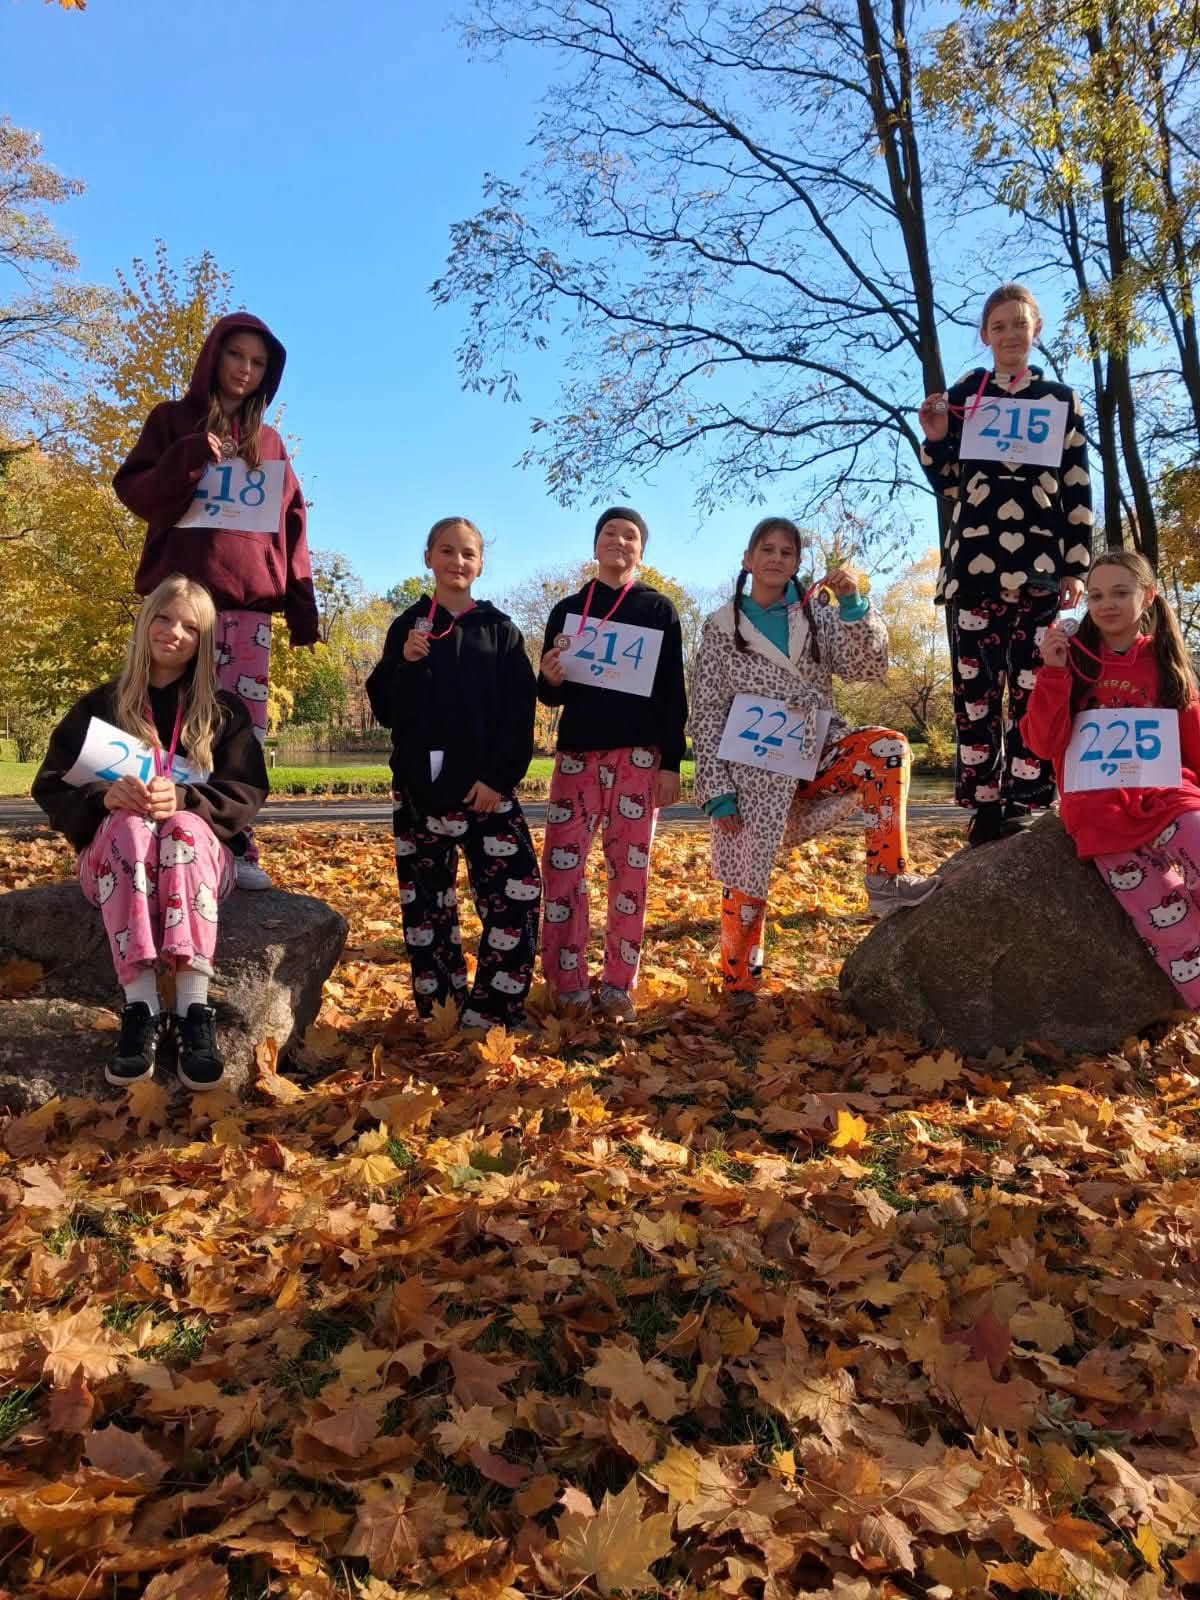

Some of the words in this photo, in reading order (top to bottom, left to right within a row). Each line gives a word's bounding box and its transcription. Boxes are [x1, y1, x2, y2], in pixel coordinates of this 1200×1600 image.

[978, 404, 1051, 444] 215
[574, 626, 645, 670] 214
[1079, 720, 1161, 761] 225
